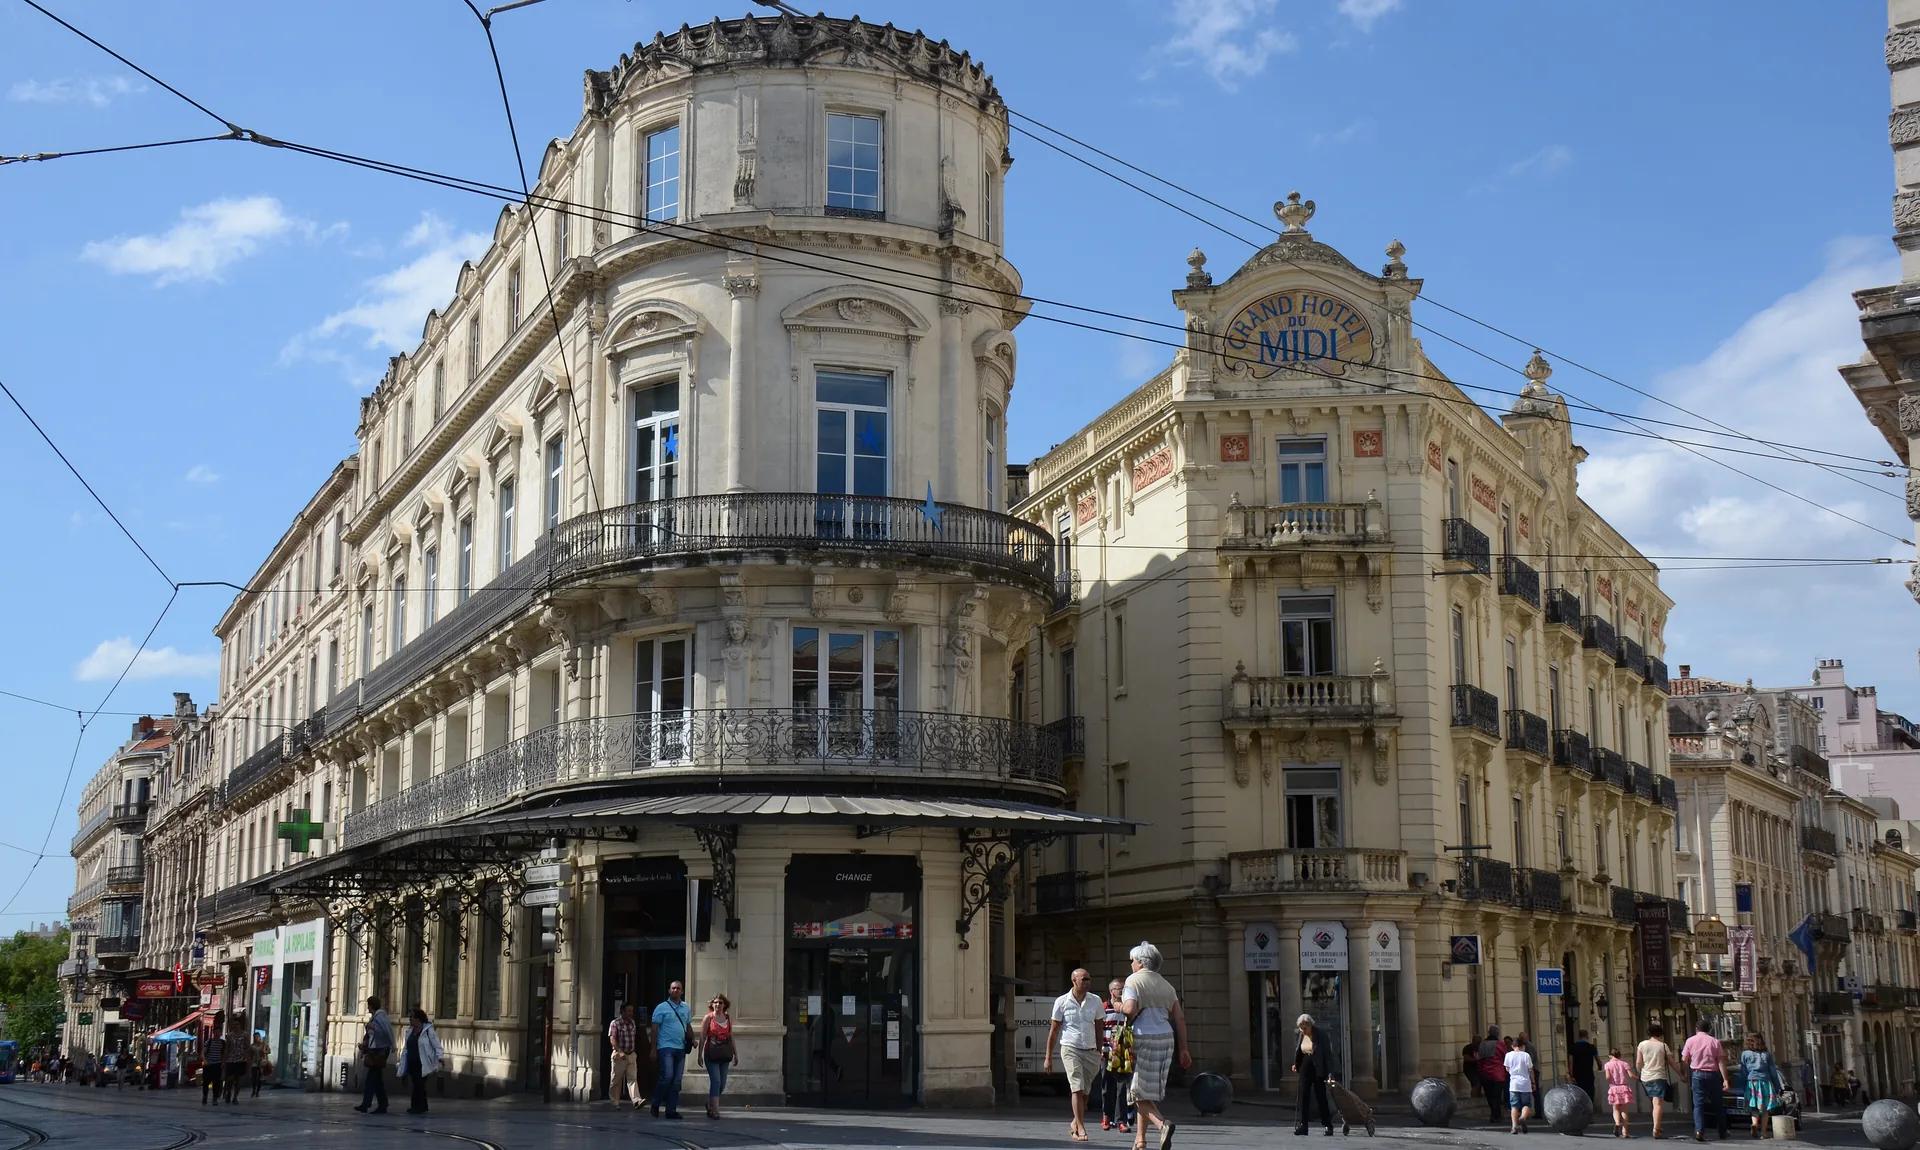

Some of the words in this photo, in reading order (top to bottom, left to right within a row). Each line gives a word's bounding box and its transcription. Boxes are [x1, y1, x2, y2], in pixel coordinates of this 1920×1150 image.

[1228, 295, 1293, 350] GRAND
[1302, 294, 1366, 343] HOTEL
[1288, 315, 1307, 327] DU
[1259, 328, 1338, 364] MIDI
[835, 873, 873, 881] CHANGE
[72, 923, 97, 931] ROYAL
[1539, 977, 1560, 986] TAXIS
